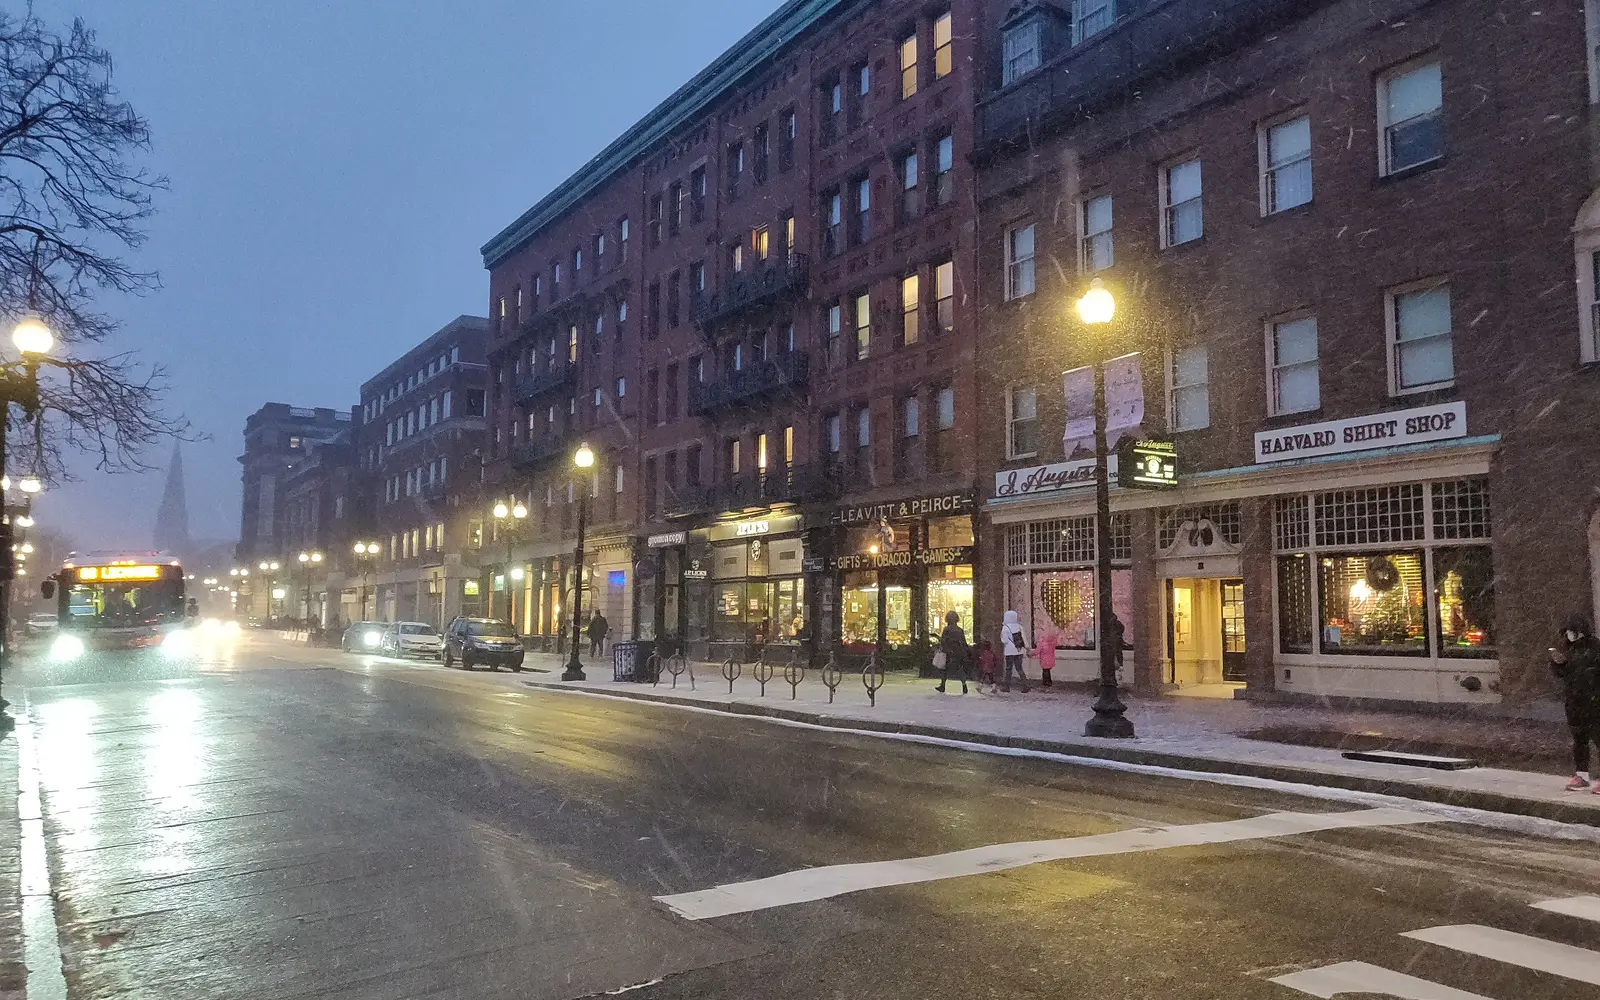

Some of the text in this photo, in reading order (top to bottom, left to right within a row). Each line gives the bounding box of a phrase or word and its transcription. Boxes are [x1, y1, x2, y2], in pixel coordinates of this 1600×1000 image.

[1260, 412, 1456, 455] HARVARD SHIRT SHOP
[841, 495, 961, 522] LEAVITT & PEIRCE
[837, 548, 955, 569] GIFTS TOBACCO GAMES
